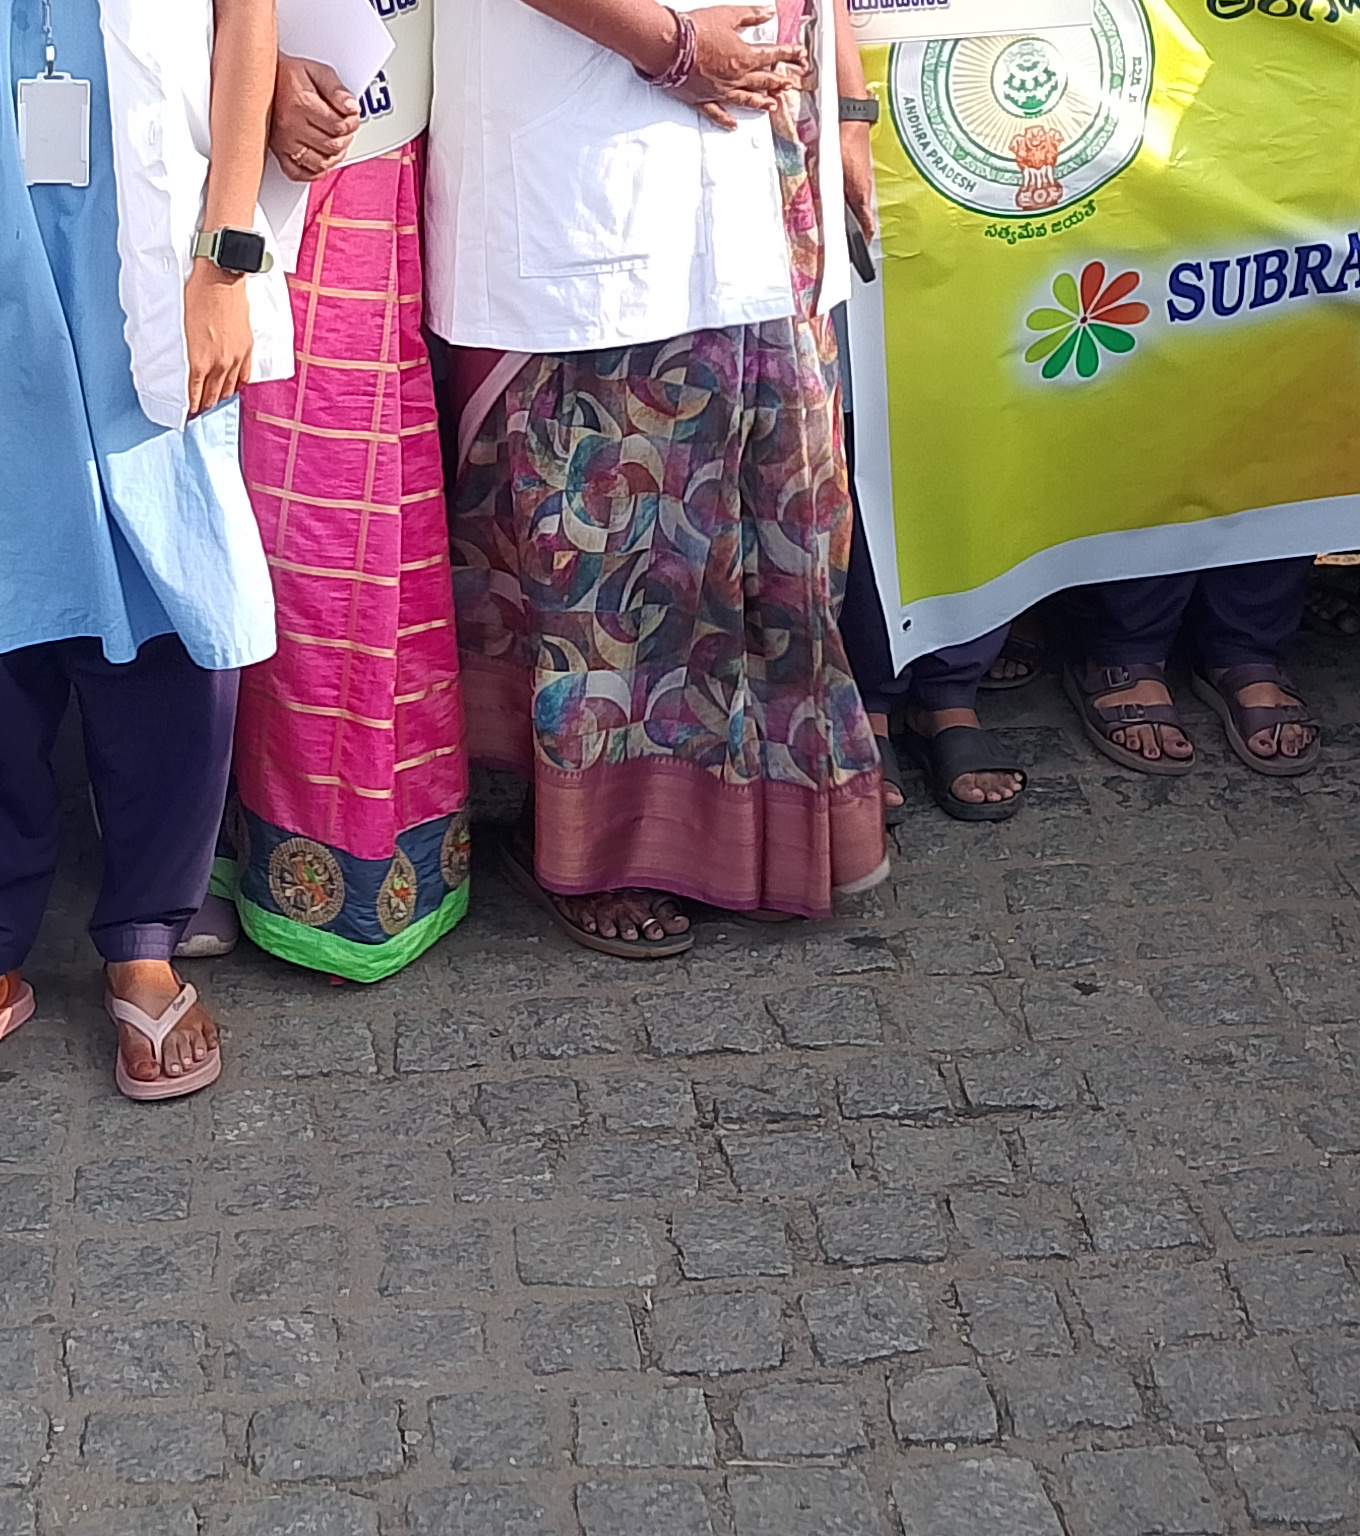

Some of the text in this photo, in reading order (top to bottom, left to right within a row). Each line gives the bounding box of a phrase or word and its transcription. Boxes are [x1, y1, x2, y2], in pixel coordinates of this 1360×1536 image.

[902, 97, 978, 193] ANDHRA PRADESH
[985, 200, 1097, 245] సత్యమేవ జయతే
